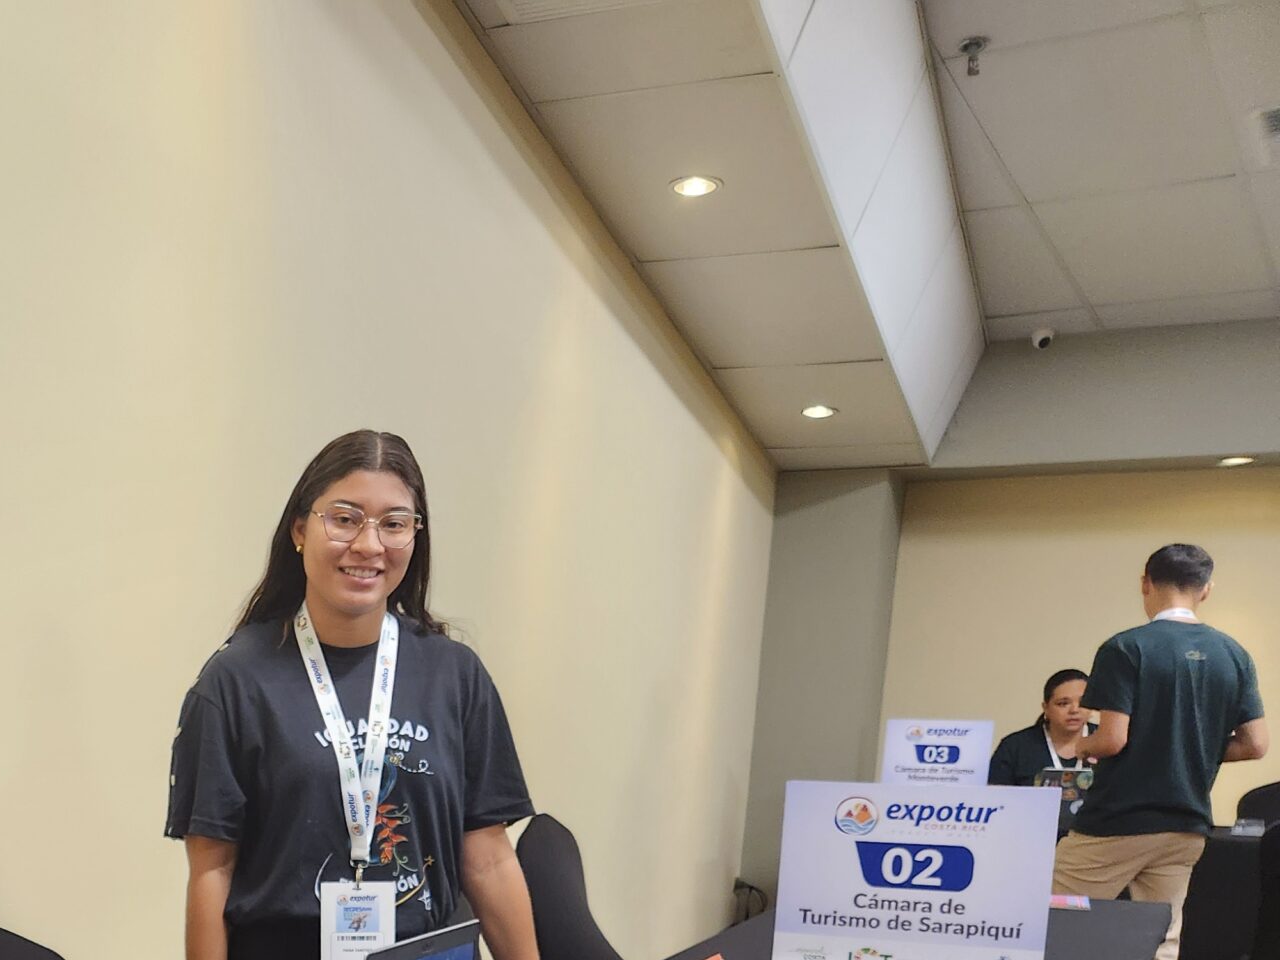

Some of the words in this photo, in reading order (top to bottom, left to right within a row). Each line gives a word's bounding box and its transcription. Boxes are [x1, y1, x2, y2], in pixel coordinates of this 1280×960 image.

[314, 718, 429, 747] IUADAD
[923, 746, 949, 763] 03
[881, 847, 944, 887] 02
[853, 893, 932, 914] Cámara
[940, 899, 966, 915] de
[799, 908, 880, 929] Turismo
[887, 915, 912, 932] de
[918, 917, 1024, 941] Sarapiquí
